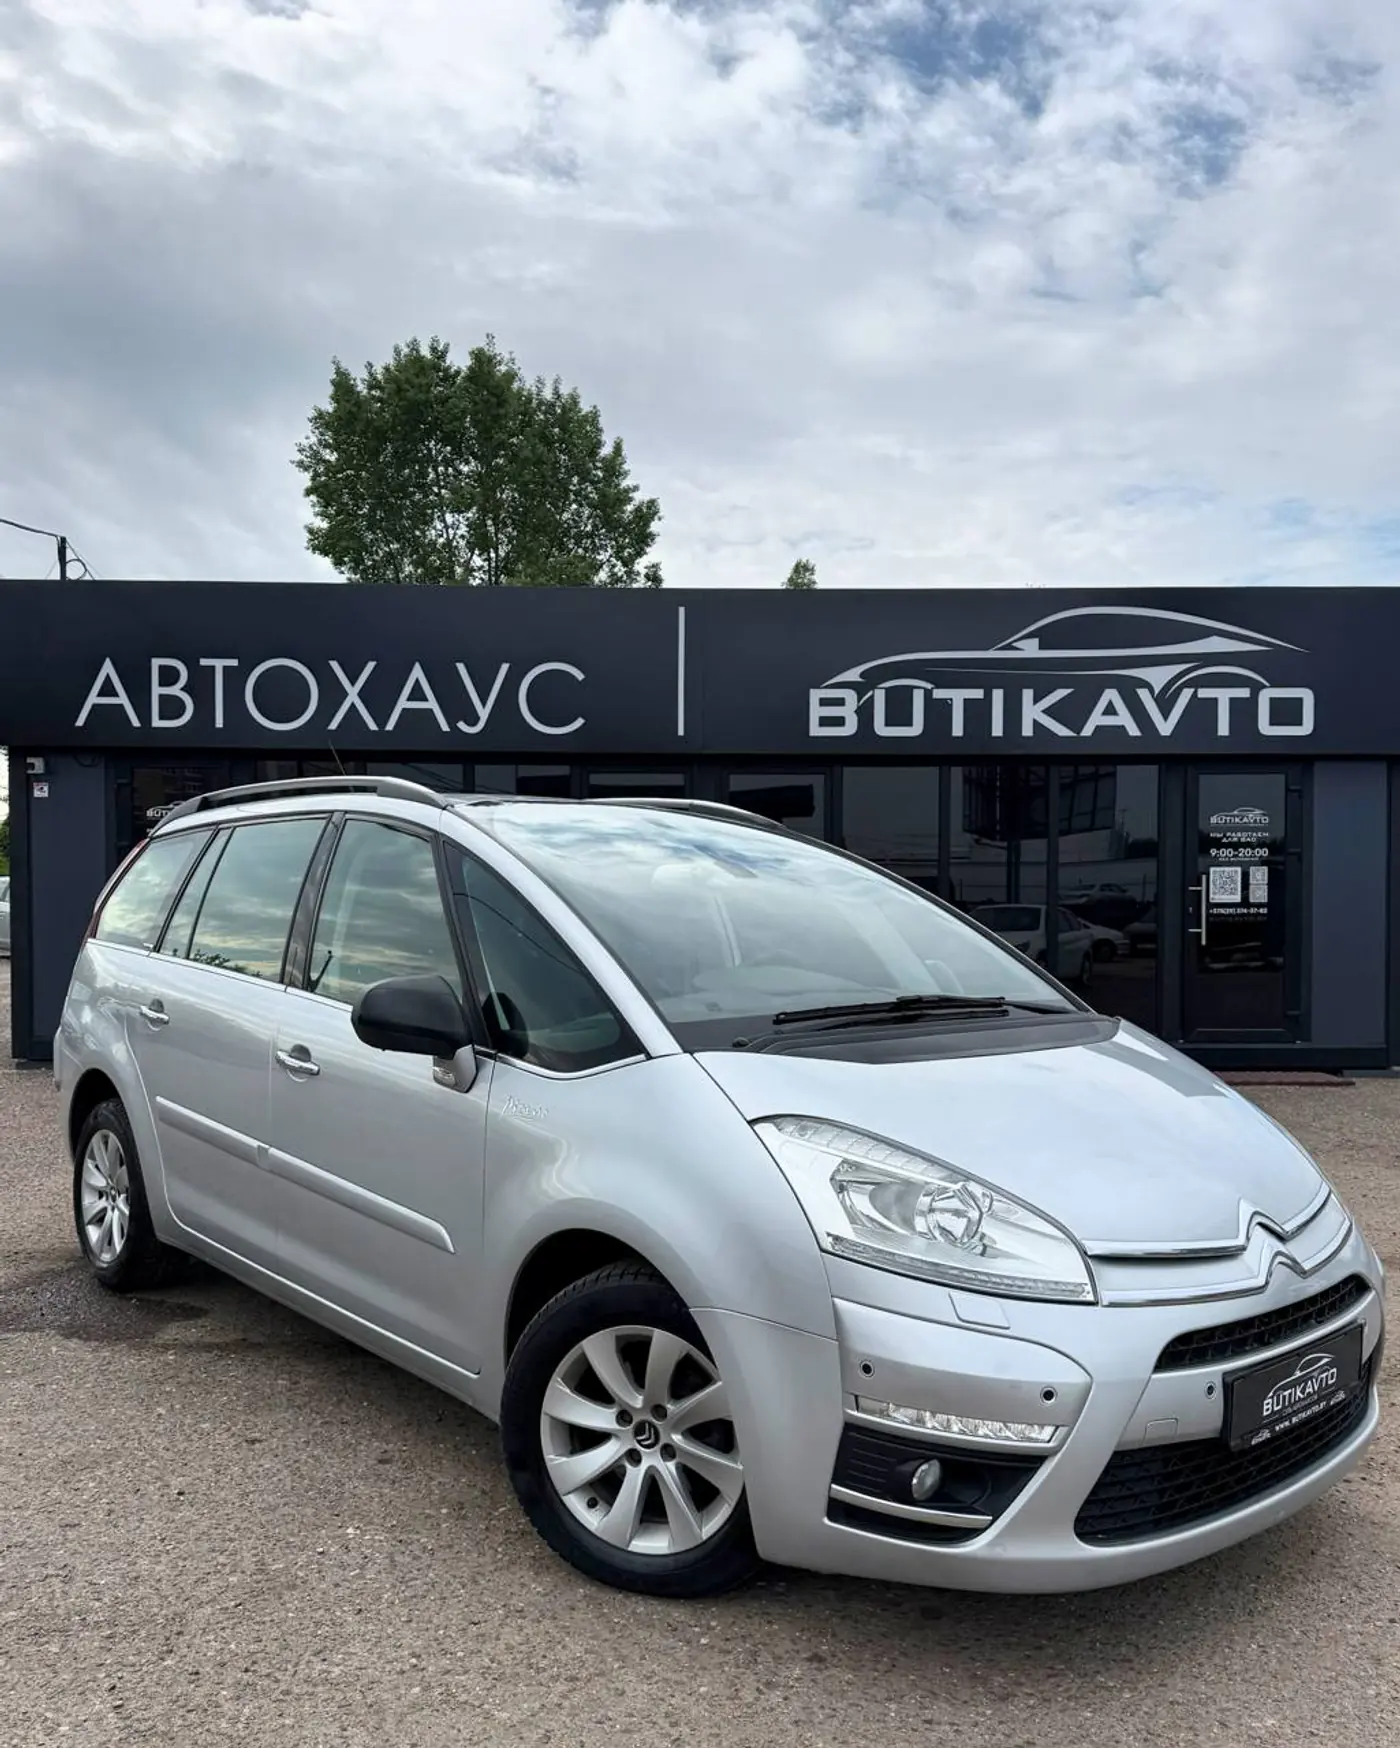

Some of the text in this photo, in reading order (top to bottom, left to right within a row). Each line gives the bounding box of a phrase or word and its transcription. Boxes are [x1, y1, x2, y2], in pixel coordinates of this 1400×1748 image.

[75, 657, 586, 735] АВТОХАУС
[809, 687, 1315, 737] BUTIKAVTO
[1210, 815, 1269, 824] BUTIKAVTO
[1210, 848, 1269, 857] 9:00-20:00
[1263, 1368, 1337, 1416] BUTIKAVTO
